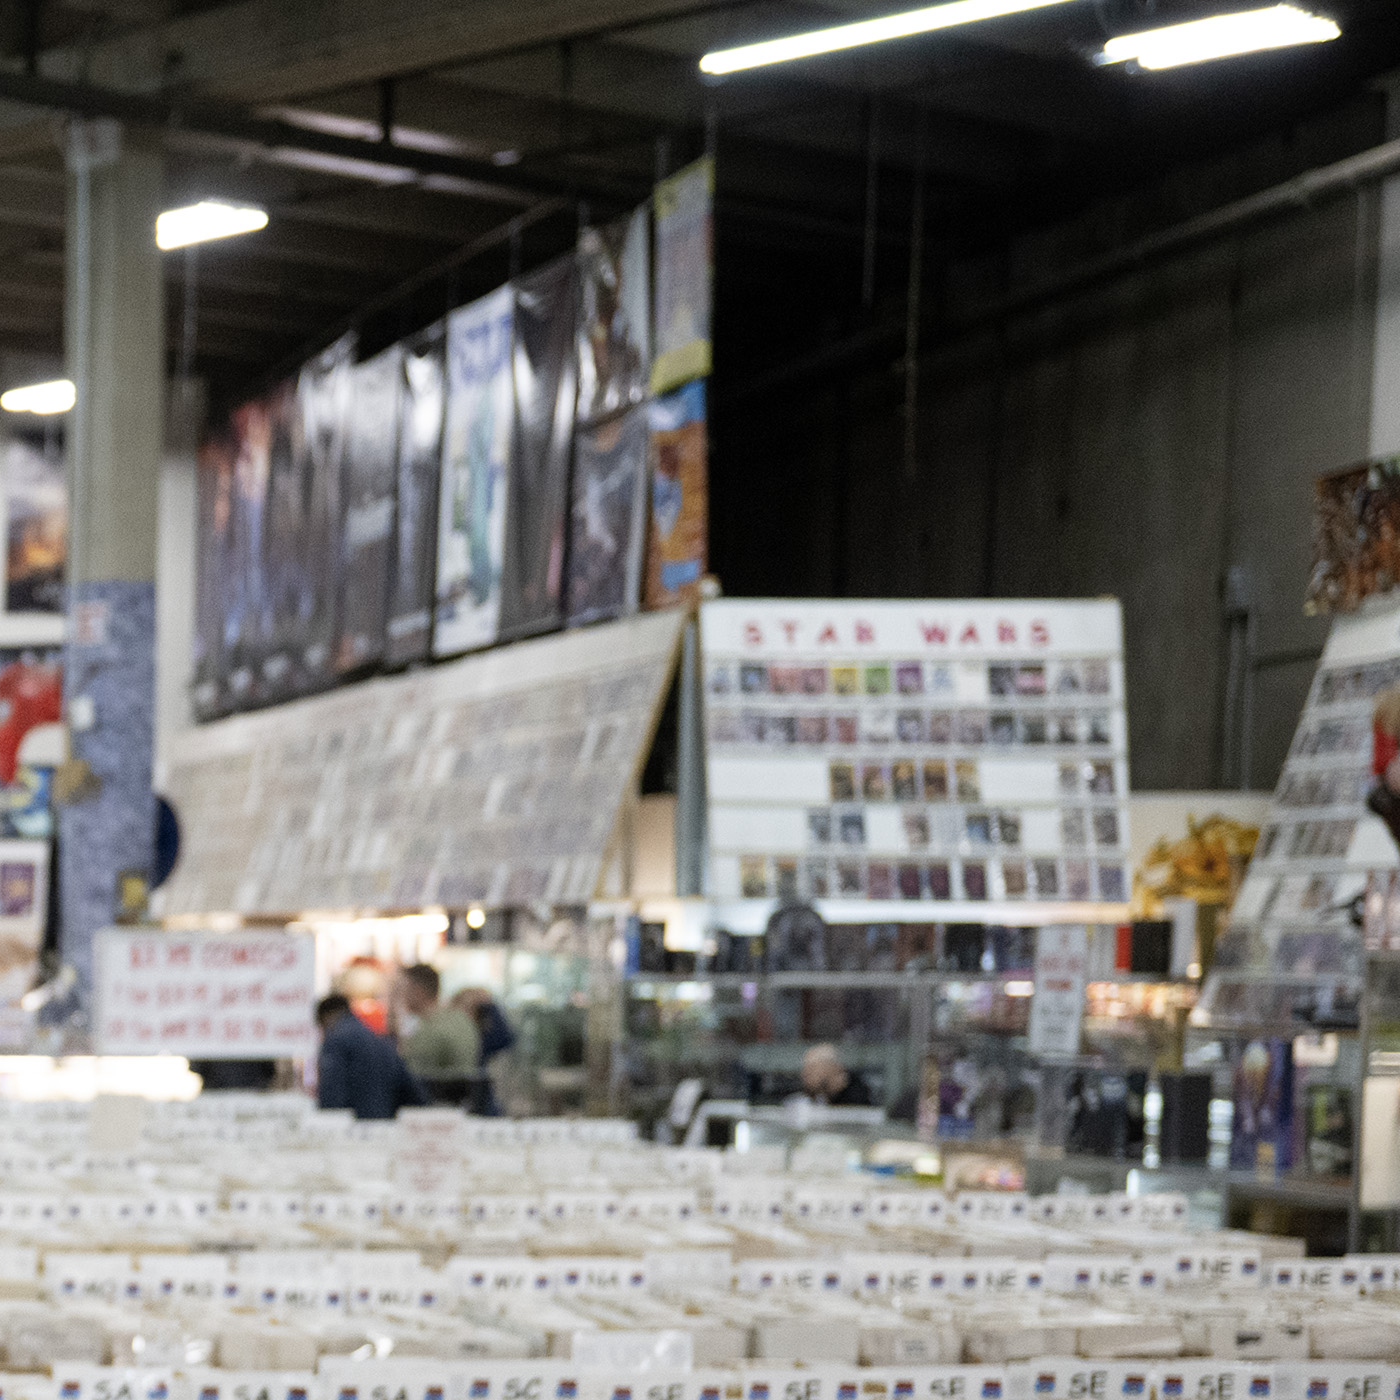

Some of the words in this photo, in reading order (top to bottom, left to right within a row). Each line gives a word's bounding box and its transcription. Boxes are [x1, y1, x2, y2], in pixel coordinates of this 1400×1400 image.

[743, 620, 876, 648] STAR
[920, 620, 1052, 648] WARS
[1068, 1370, 1108, 1400] SE
